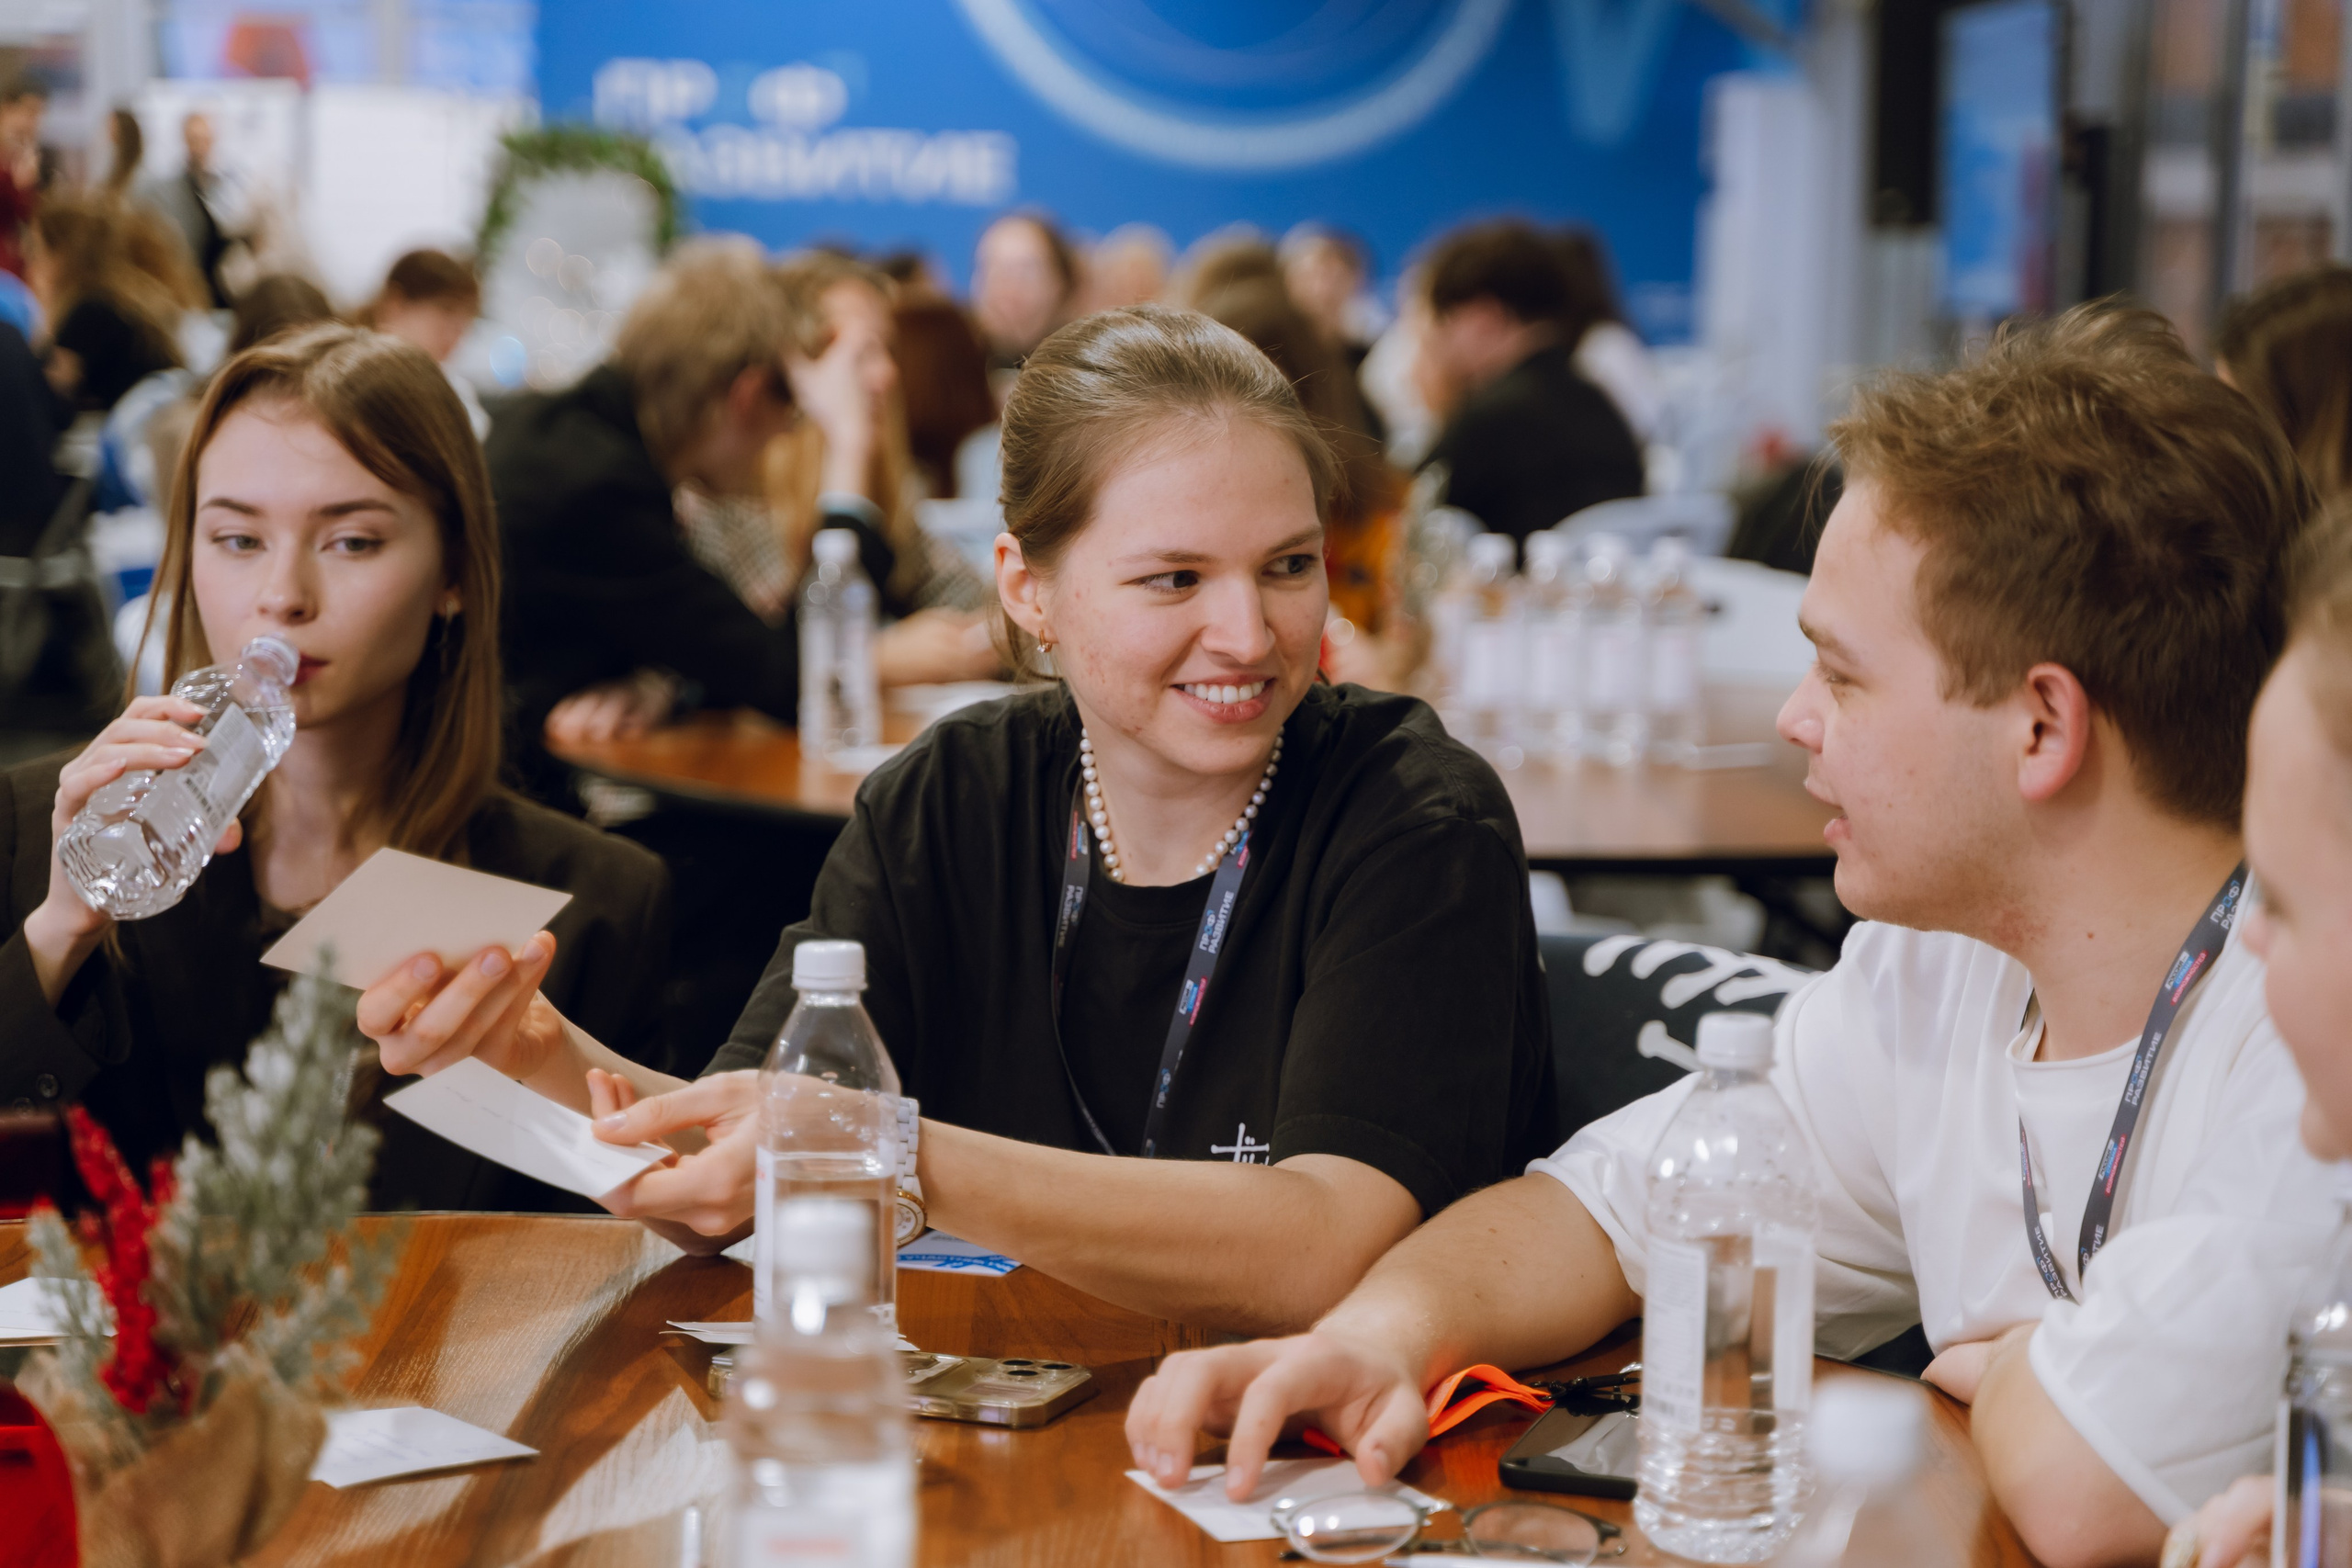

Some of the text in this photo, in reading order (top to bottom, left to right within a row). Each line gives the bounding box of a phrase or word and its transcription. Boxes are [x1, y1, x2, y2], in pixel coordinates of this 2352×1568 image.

[1199, 914, 1216, 951] ПРОФ
[1208, 890, 1235, 954] РАЗВИТИЕ
[2125, 1060, 2143, 1102] ПРОФ
[2132, 1032, 2162, 1106] РАЗВИТИЕ
[2034, 1225, 2067, 1297] РАЗВИТИЕ
